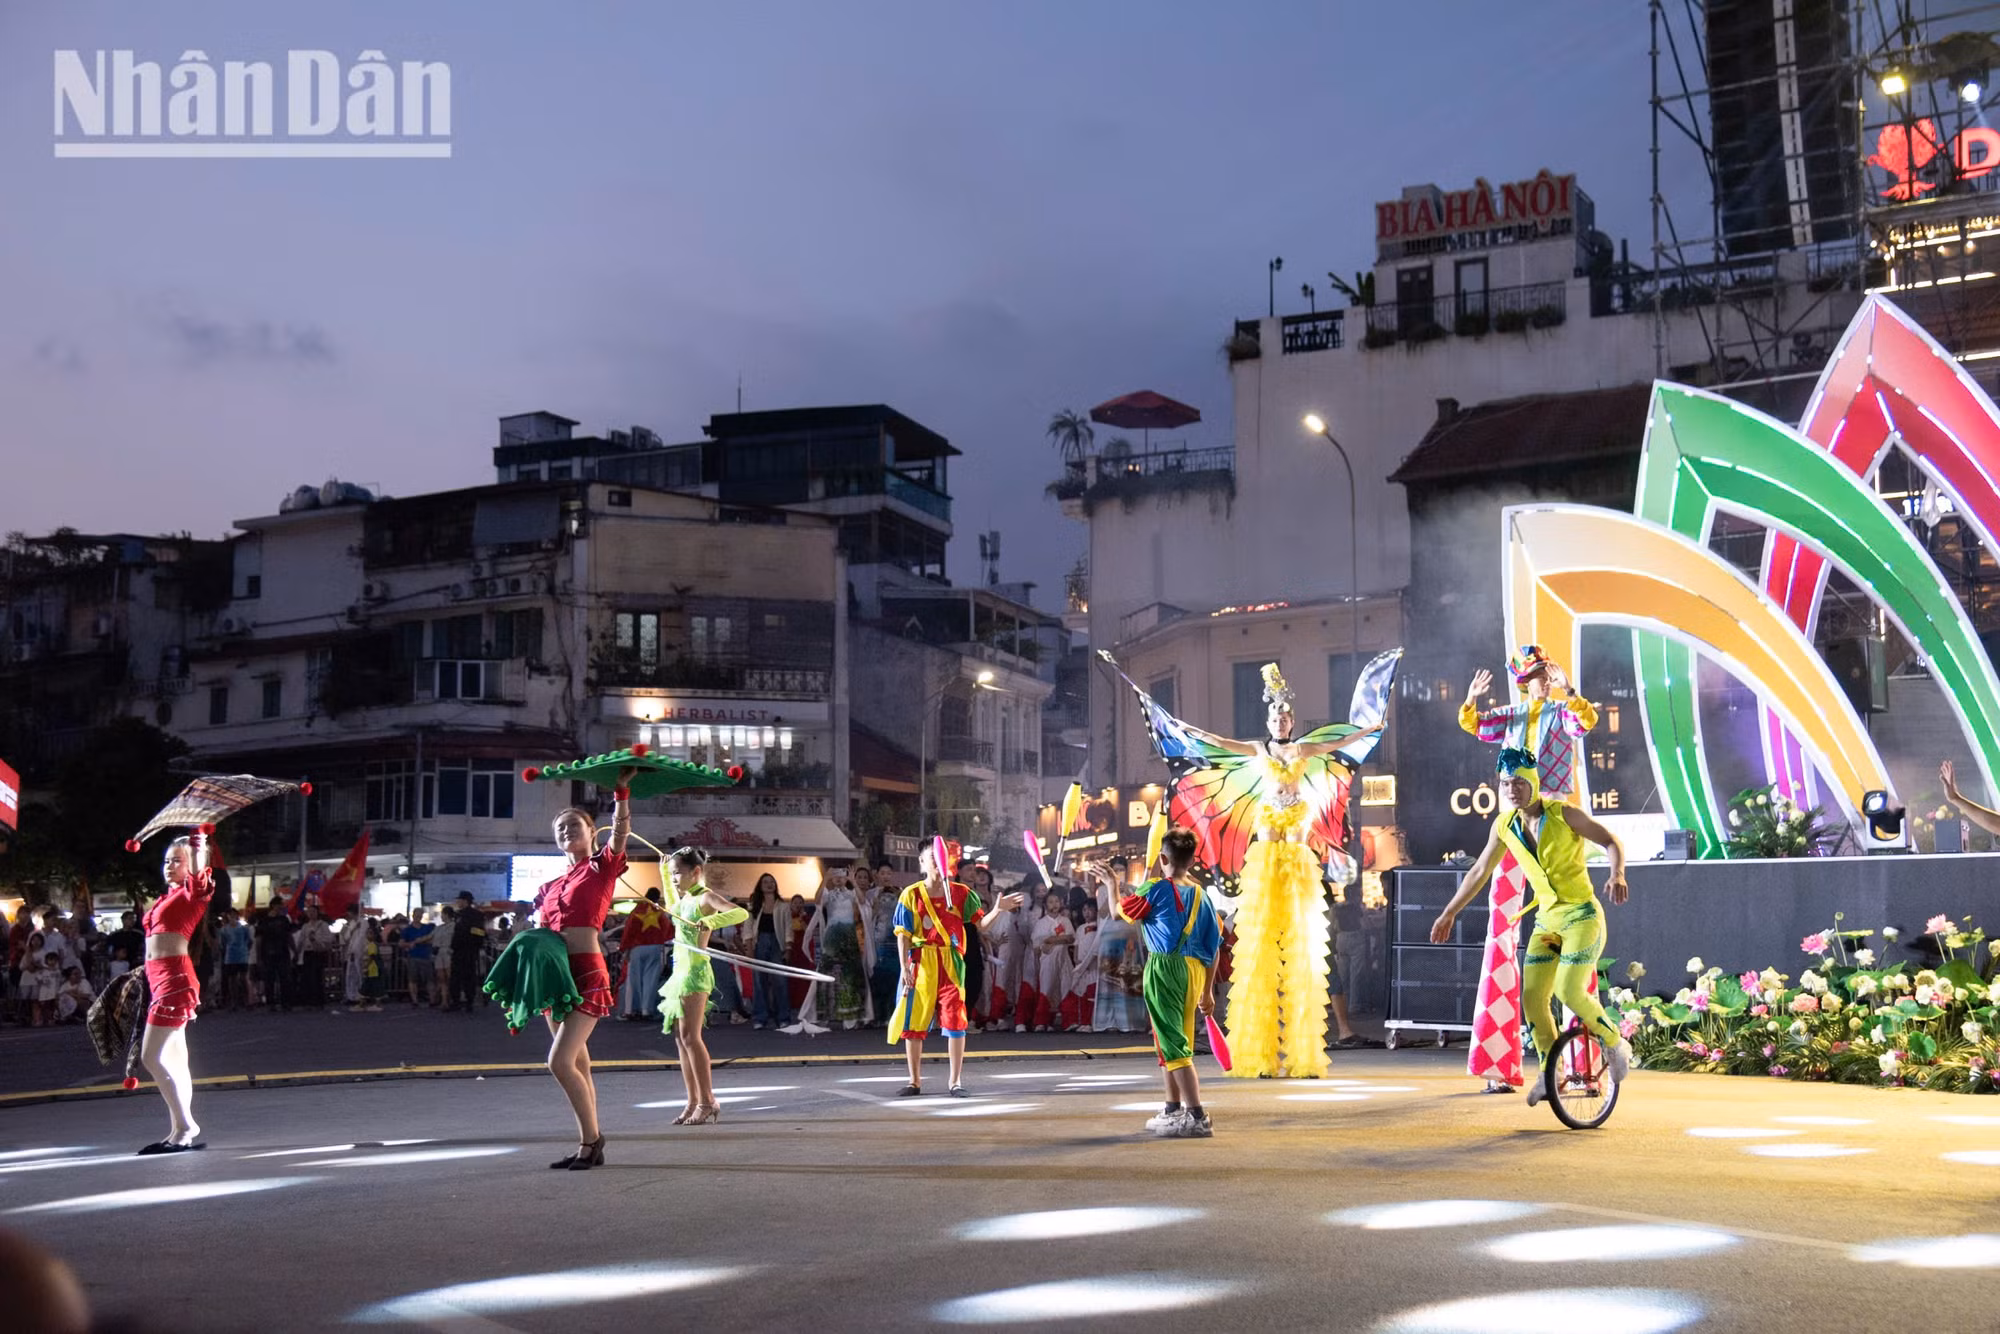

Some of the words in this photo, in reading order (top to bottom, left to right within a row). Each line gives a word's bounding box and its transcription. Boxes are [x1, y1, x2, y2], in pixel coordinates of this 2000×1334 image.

[1376, 197, 1438, 240] BIA
[1443, 178, 1498, 231] HÀ
[1501, 168, 1575, 228] NỘI
[663, 706, 769, 722] HERBALIST
[1450, 782, 1497, 820] CỘ
[1592, 788, 1619, 809] HÊ
